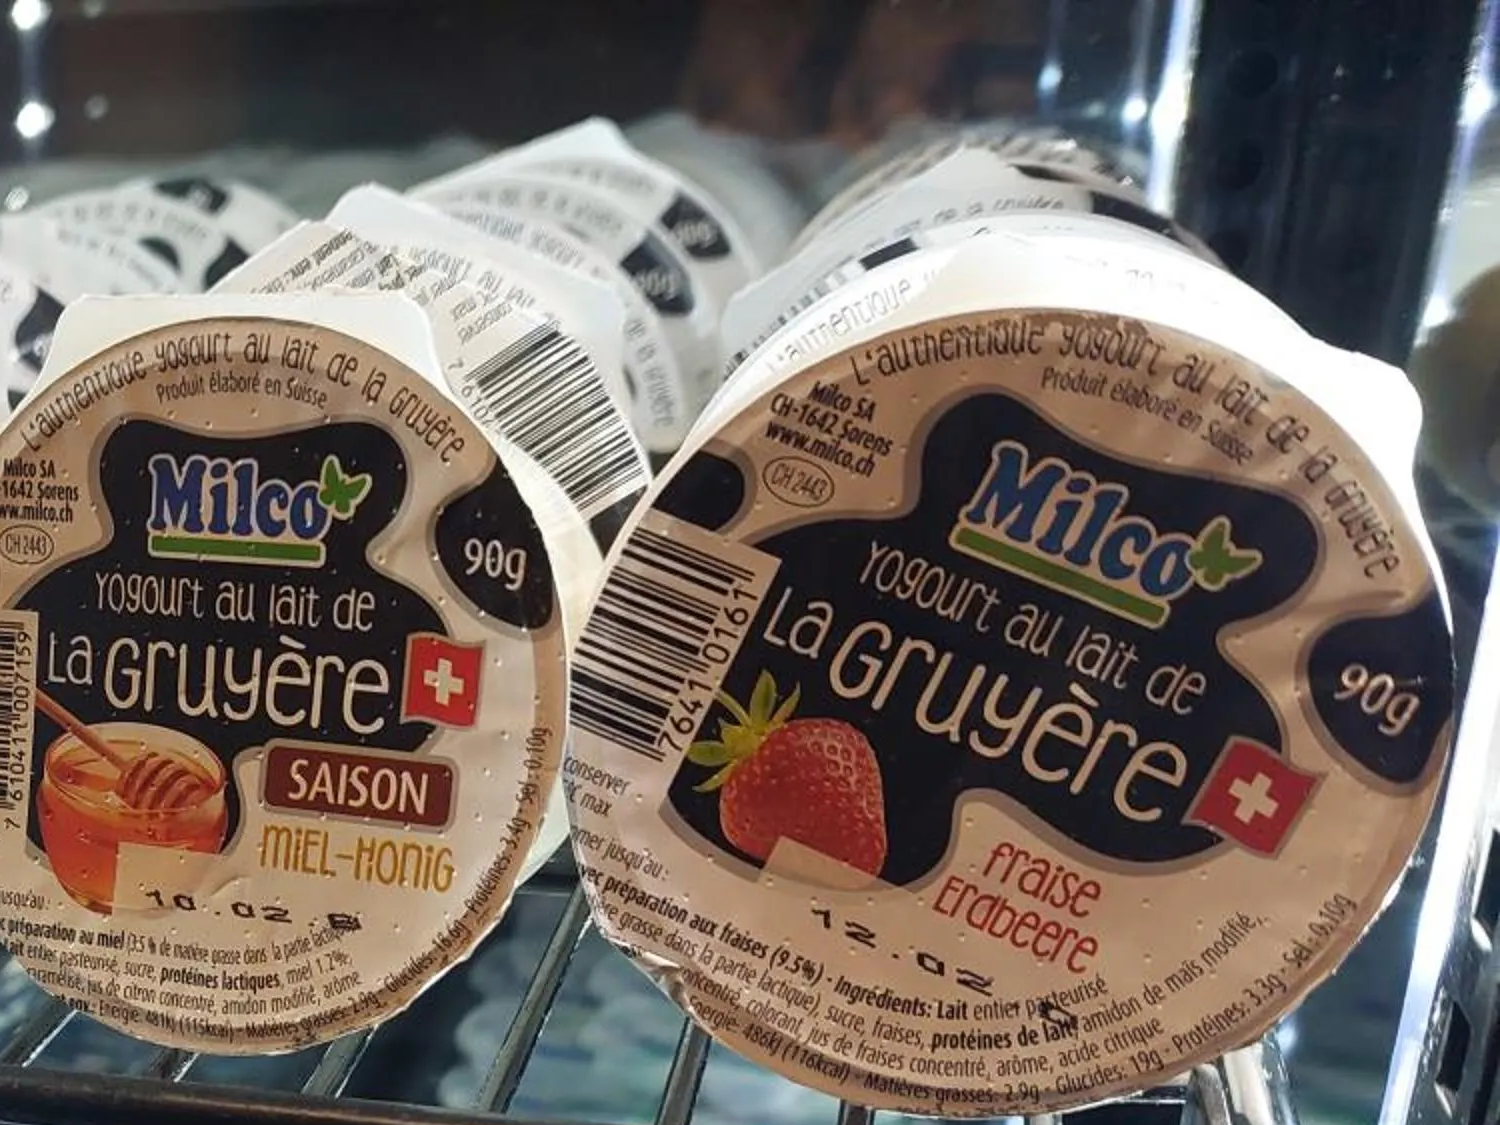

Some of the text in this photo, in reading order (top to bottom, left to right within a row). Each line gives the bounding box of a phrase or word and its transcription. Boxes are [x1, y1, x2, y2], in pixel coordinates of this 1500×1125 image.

[21, 331, 387, 453] L'authentique yogourt au lait de la
[155, 371, 329, 411] Produit élaboré en Suisse
[770, 393, 894, 457] CH-1642 Sorens
[808, 380, 877, 423] Milco SA
[850, 318, 1339, 483] L'authentique yogourt au lait de la
[1041, 366, 1253, 467] Produit Suisse
[3, 457, 56, 479] Milco SA
[765, 421, 877, 477] www.milco.ch
[37, 482, 80, 502] Sorens
[146, 453, 335, 543] Milco
[959, 440, 1203, 600] Milco
[95, 570, 377, 632] Yogourt au lait de
[464, 537, 529, 592] 90g
[859, 540, 1207, 716] Yogourt au lait de
[46, 630, 391, 736] La Gruyère
[763, 586, 1188, 823] La Gruyère
[1334, 663, 1426, 738] 90g
[288, 758, 430, 816] SAISON
[982, 841, 1102, 918] fraise
[8, 918, 125, 949] préparation miel
[604, 872, 1021, 1022] préparation aux fraises (9.5%) Ingrédients: Lait entier
[931, 874, 1099, 975] Erdbeere
[159, 965, 220, 991] protéines
[618, 911, 1142, 1053] grasse fraises, protéines de amidon
[855, 1014, 1166, 1081] fraises concentré, acide citrique
[1054, 999, 1252, 1096] Glucides: Protéines:
